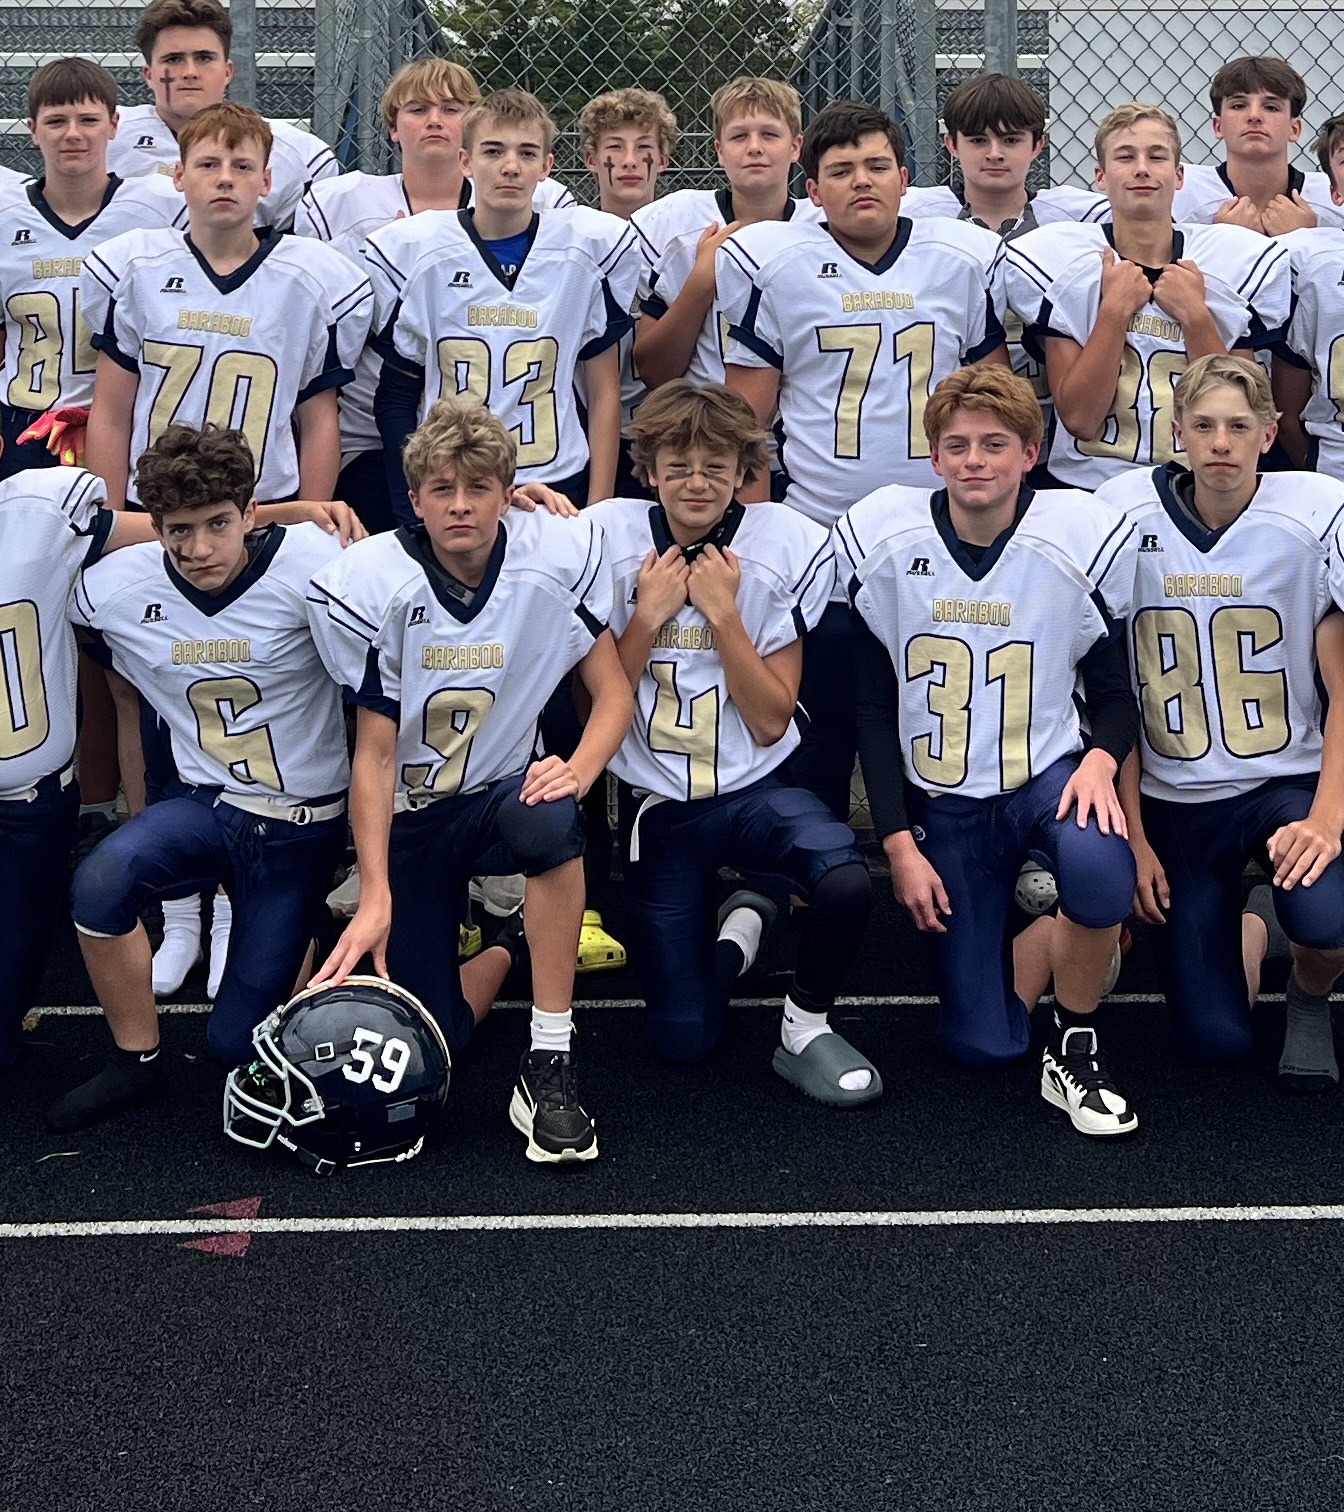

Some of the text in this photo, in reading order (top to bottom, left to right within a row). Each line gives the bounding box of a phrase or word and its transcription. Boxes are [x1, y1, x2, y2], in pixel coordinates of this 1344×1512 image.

[177, 310, 253, 338] BARABOO
[468, 304, 538, 328] BARABOO
[842, 291, 914, 312] BARABOO
[143, 338, 278, 482] 70
[817, 321, 935, 460] 71
[933, 598, 1011, 626] BARABOO
[1164, 573, 1242, 598] BARABOO
[172, 639, 251, 665] BARABOO
[422, 644, 504, 670] BARABOO
[1134, 605, 1291, 761] 86
[186, 676, 284, 791] 6
[401, 687, 496, 798] 9
[648, 661, 719, 802] 4
[905, 634, 1034, 796] 31
[342, 1027, 411, 1094] 59
